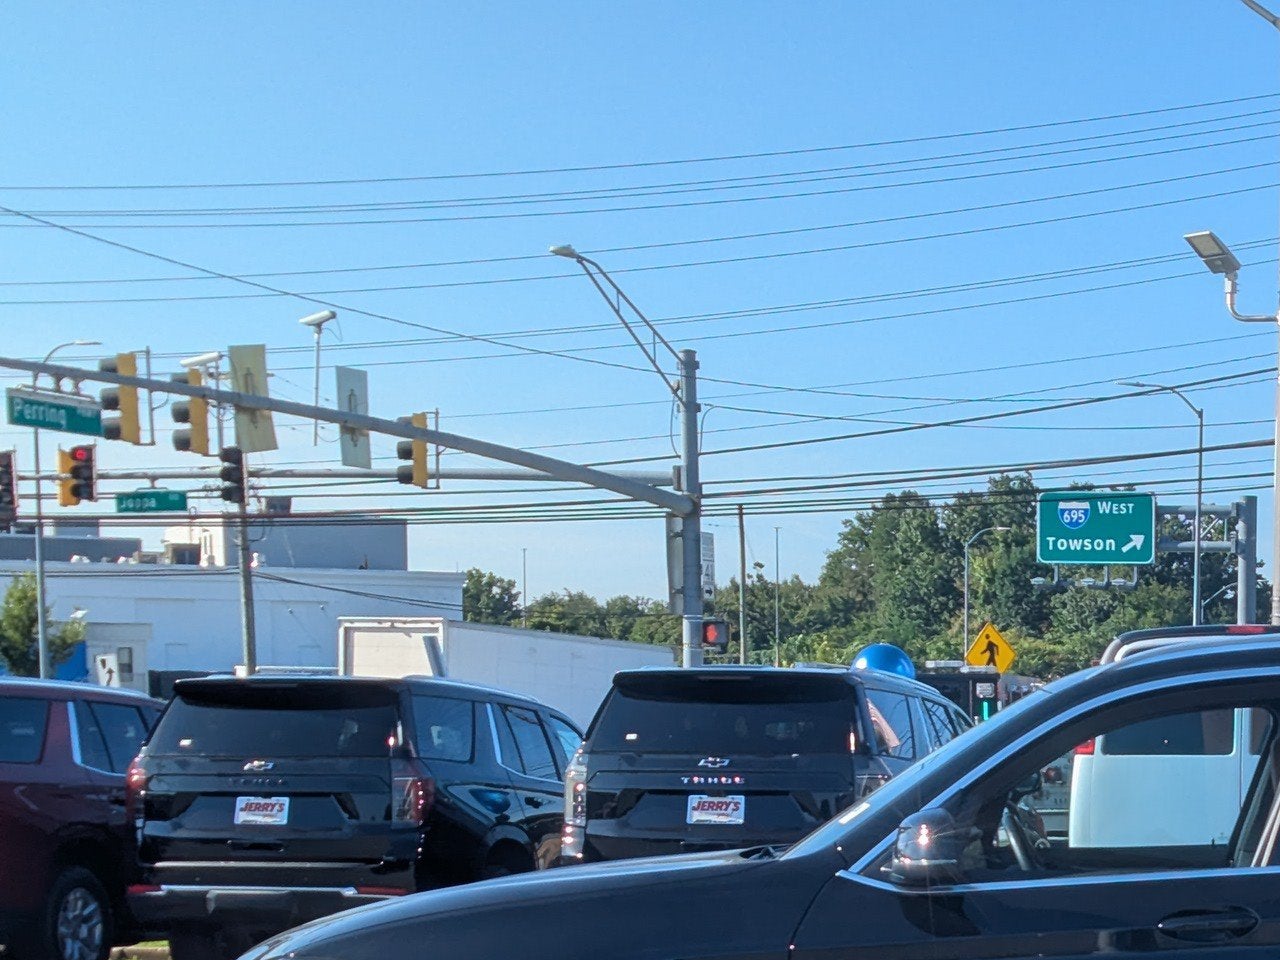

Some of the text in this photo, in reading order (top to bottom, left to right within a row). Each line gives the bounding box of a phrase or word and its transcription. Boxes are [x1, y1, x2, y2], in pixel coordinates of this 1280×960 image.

[13, 399, 67, 429] Perring
[1063, 509, 1085, 523] 695
[1046, 536, 1116, 551] Towson
[239, 802, 285, 812] JERRY'S
[692, 800, 741, 812] JERRY'S
